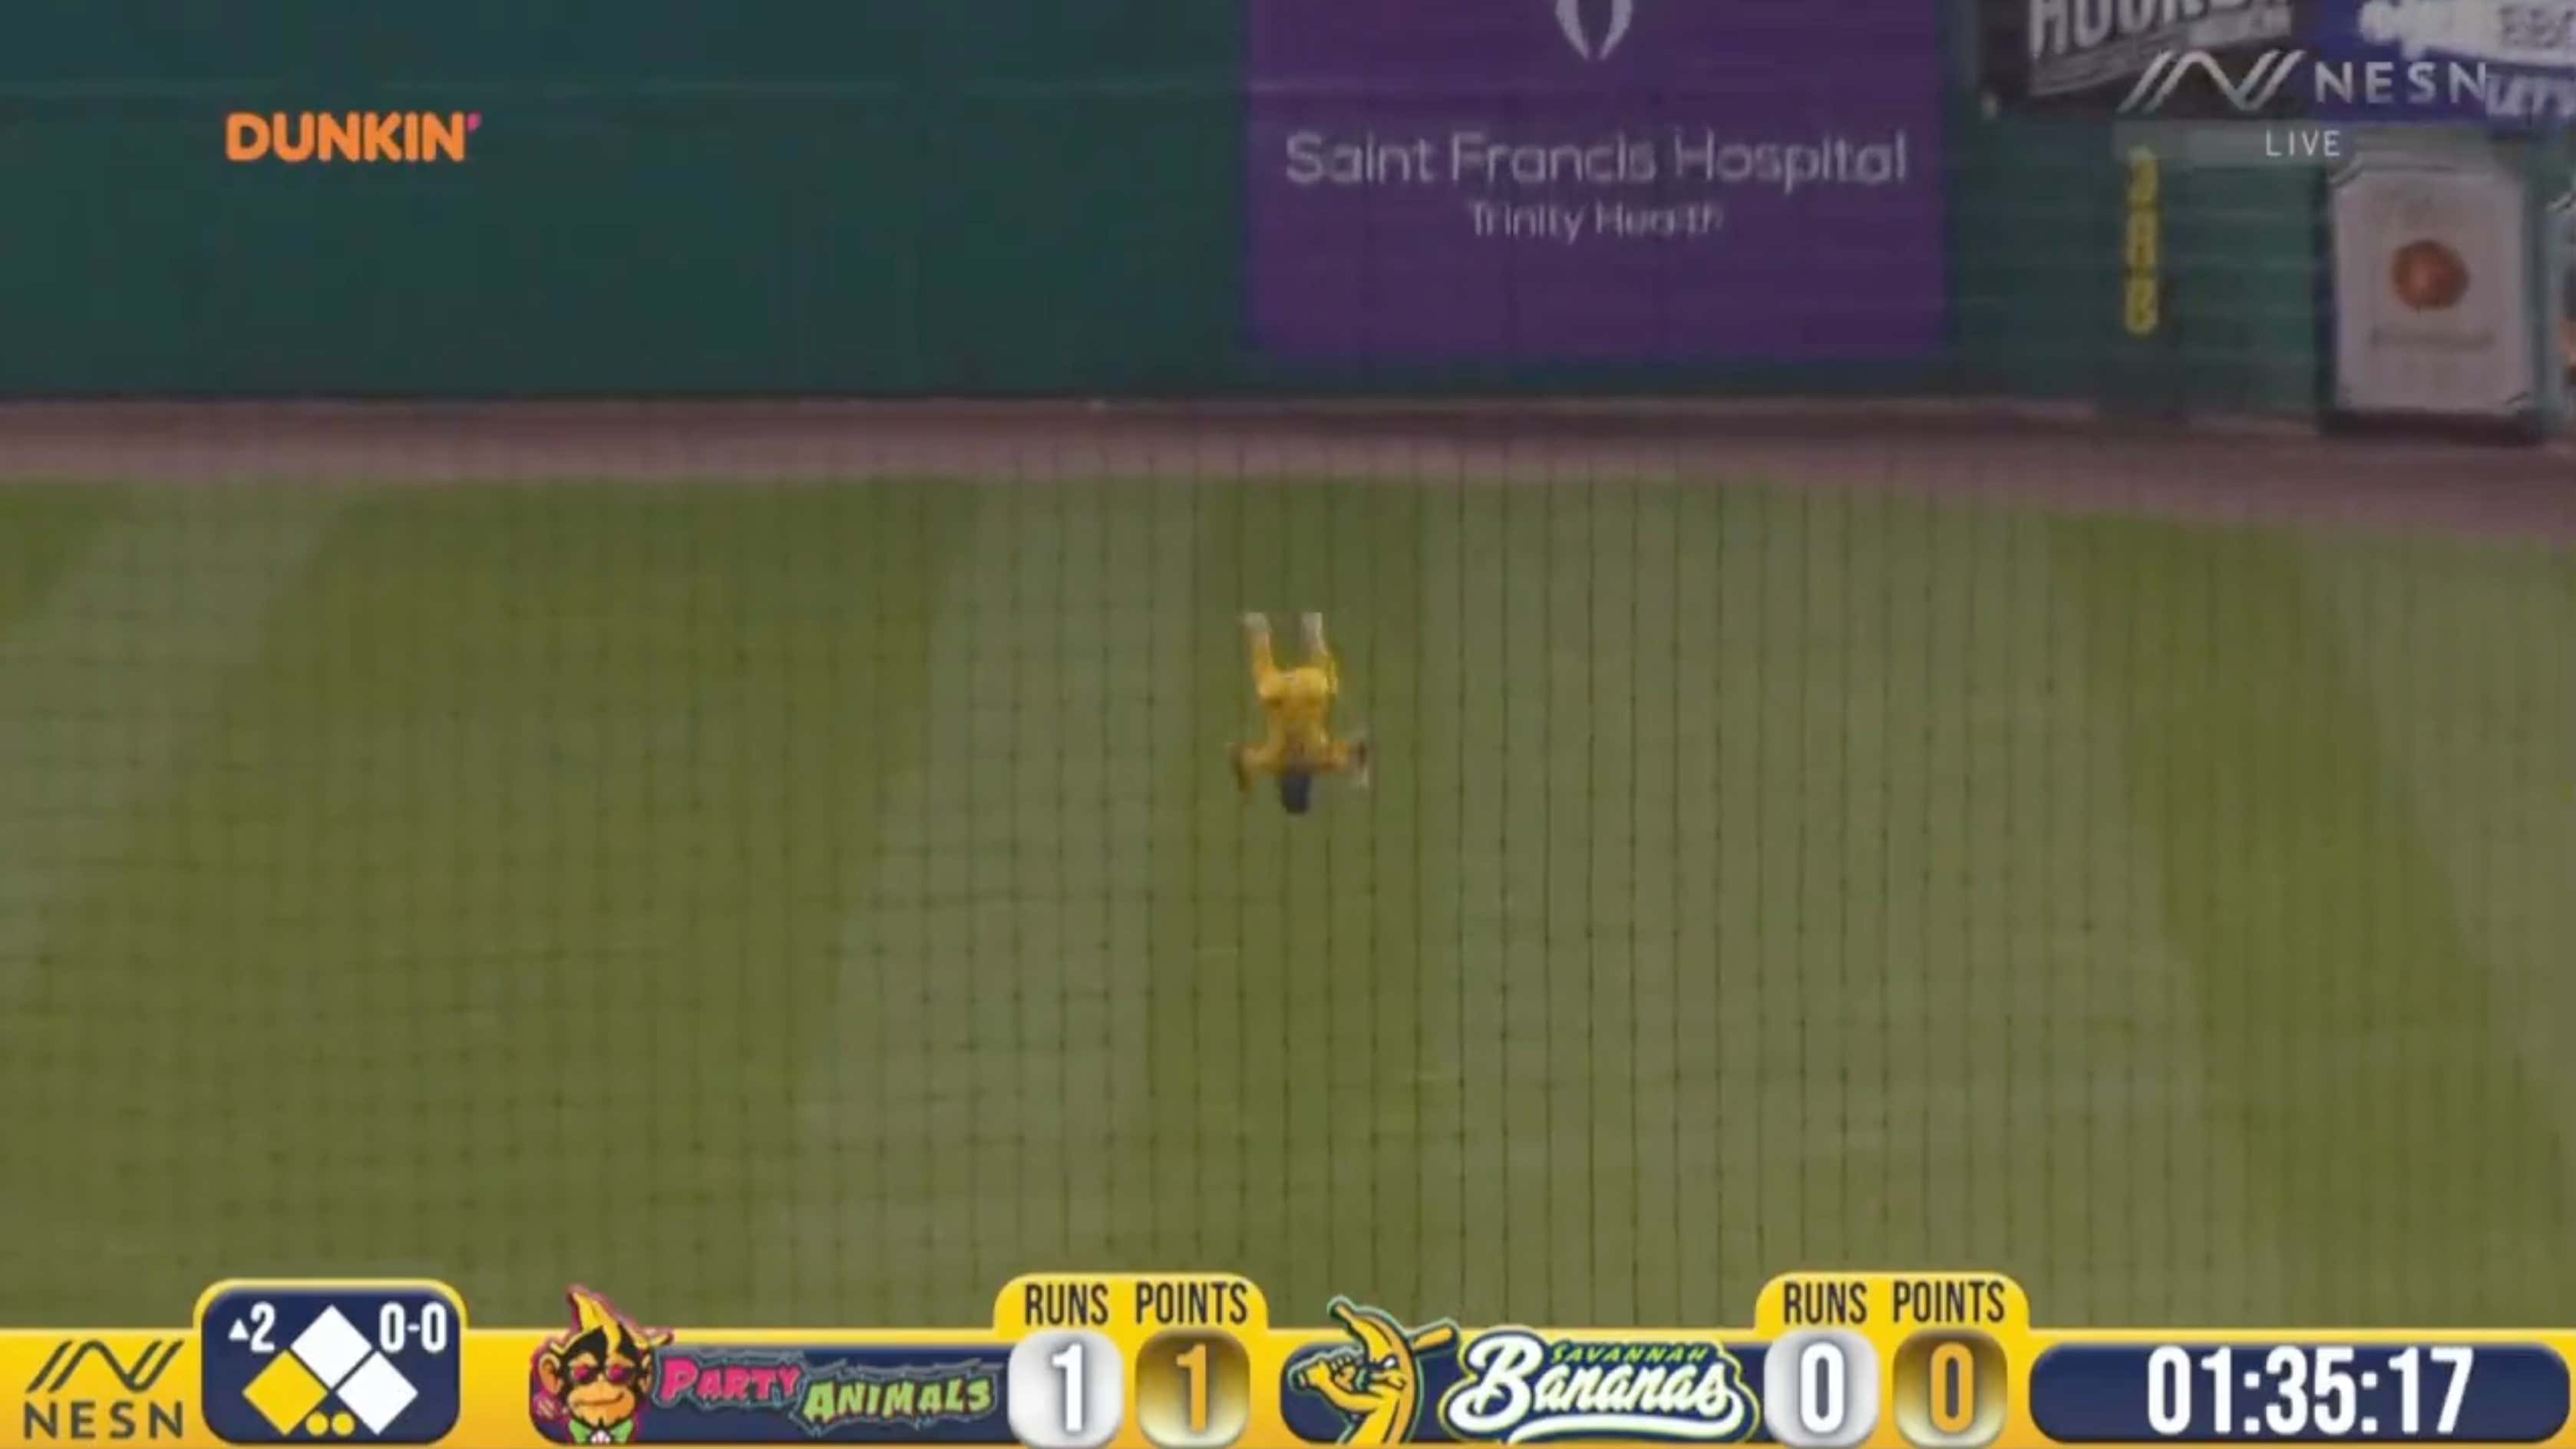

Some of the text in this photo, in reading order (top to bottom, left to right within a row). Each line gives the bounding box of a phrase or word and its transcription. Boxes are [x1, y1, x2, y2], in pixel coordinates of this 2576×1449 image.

[1286, 127, 1907, 195] Saint Francis Hospital
[1466, 198, 1587, 246] Trinity
